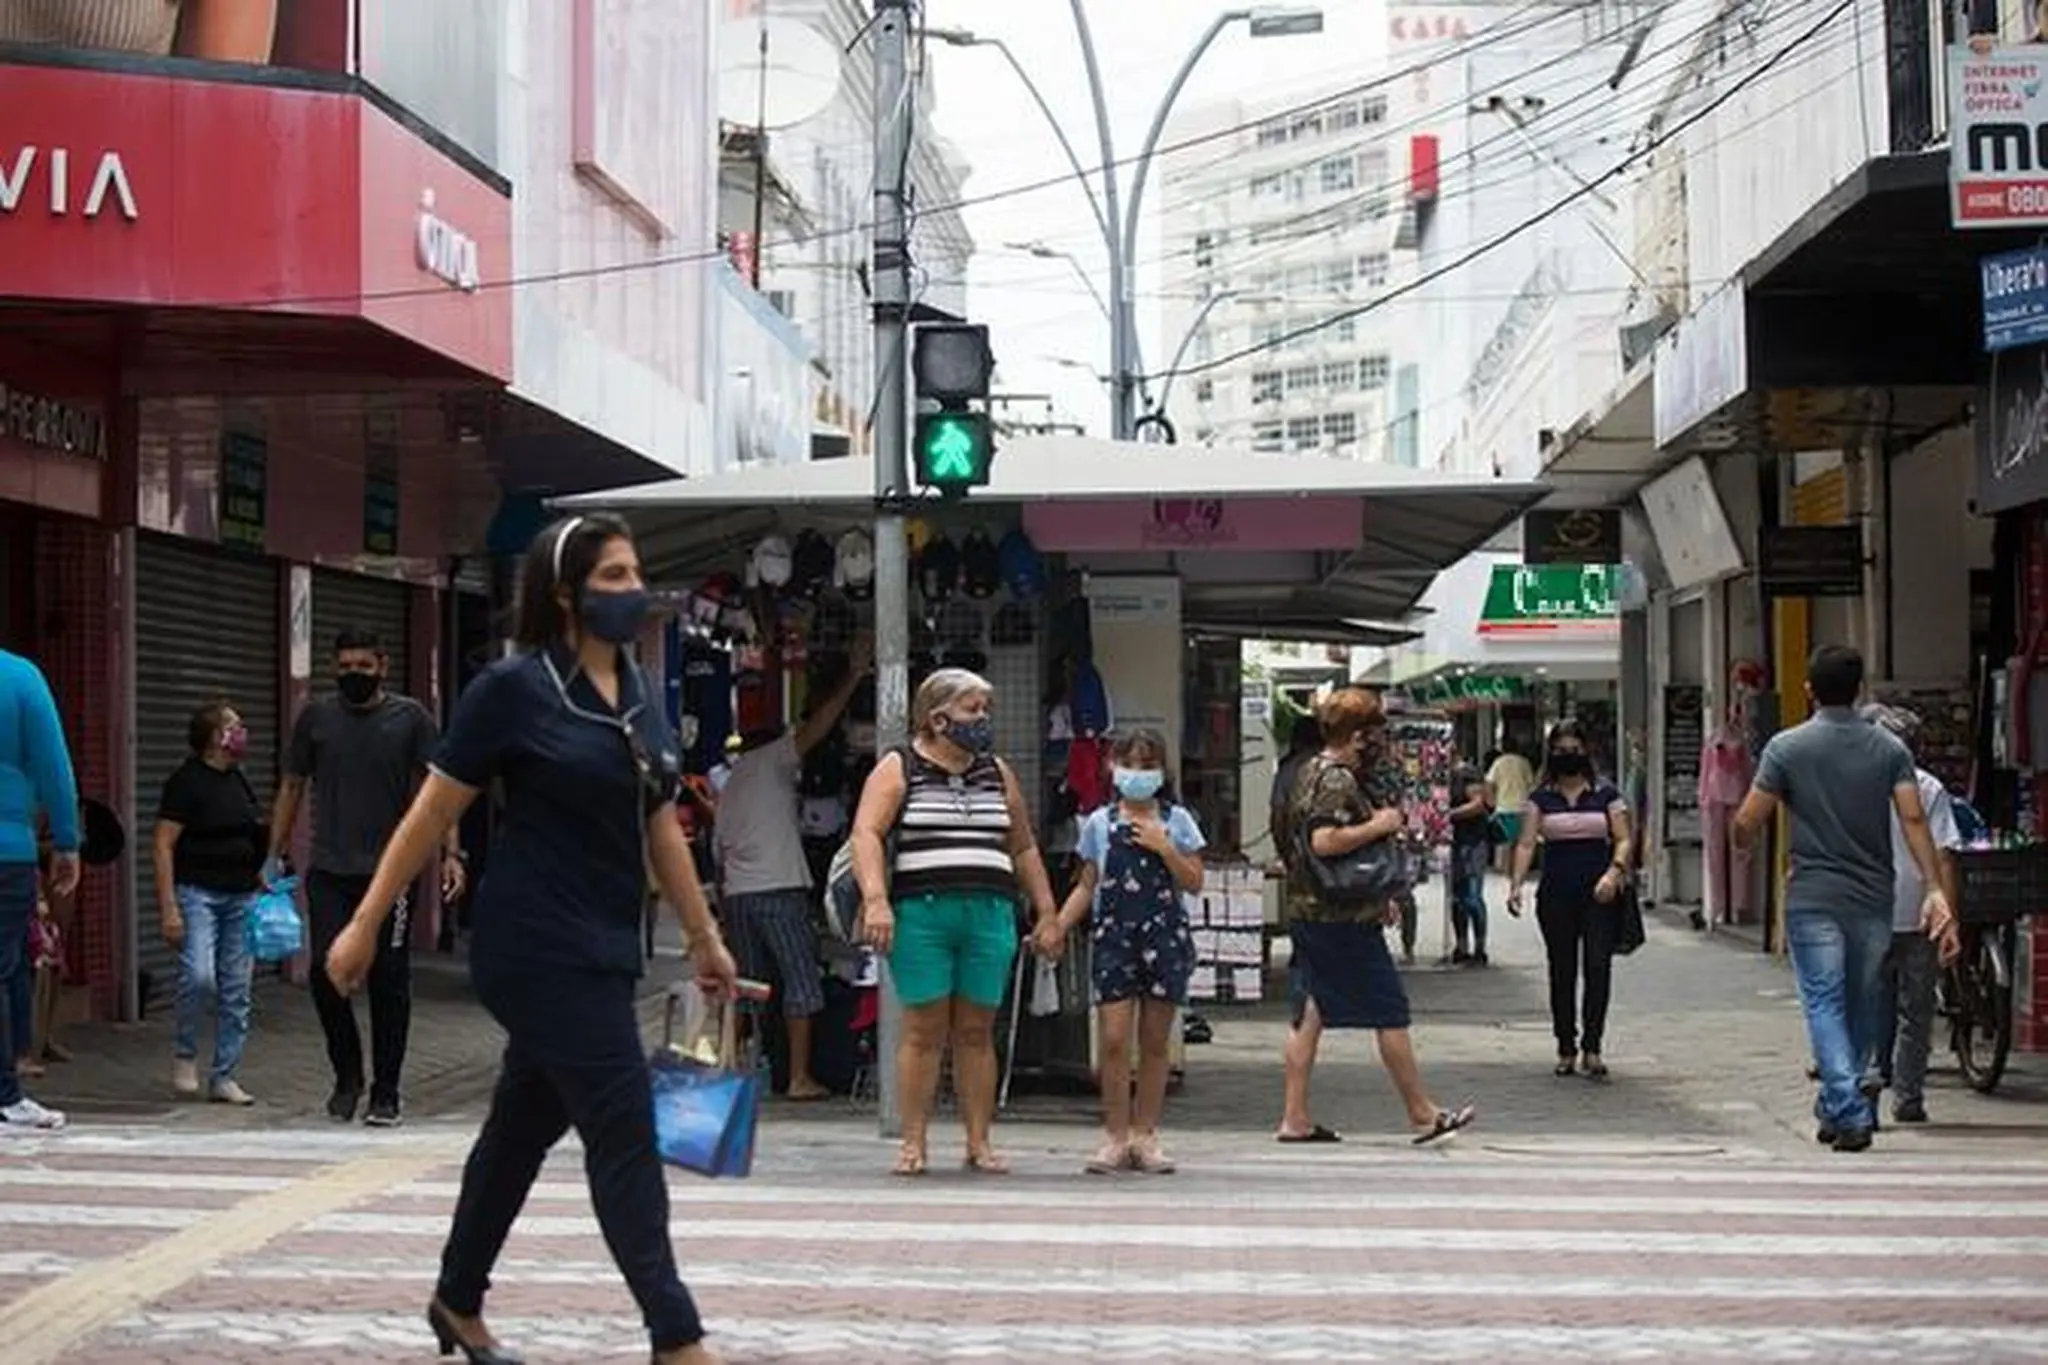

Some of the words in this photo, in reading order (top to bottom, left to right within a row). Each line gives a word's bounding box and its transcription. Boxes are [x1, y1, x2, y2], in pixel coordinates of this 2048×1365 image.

[1963, 64, 2037, 79] INTERNET
[1963, 81, 2011, 96] FIBRA
[1968, 122, 2048, 172] m
